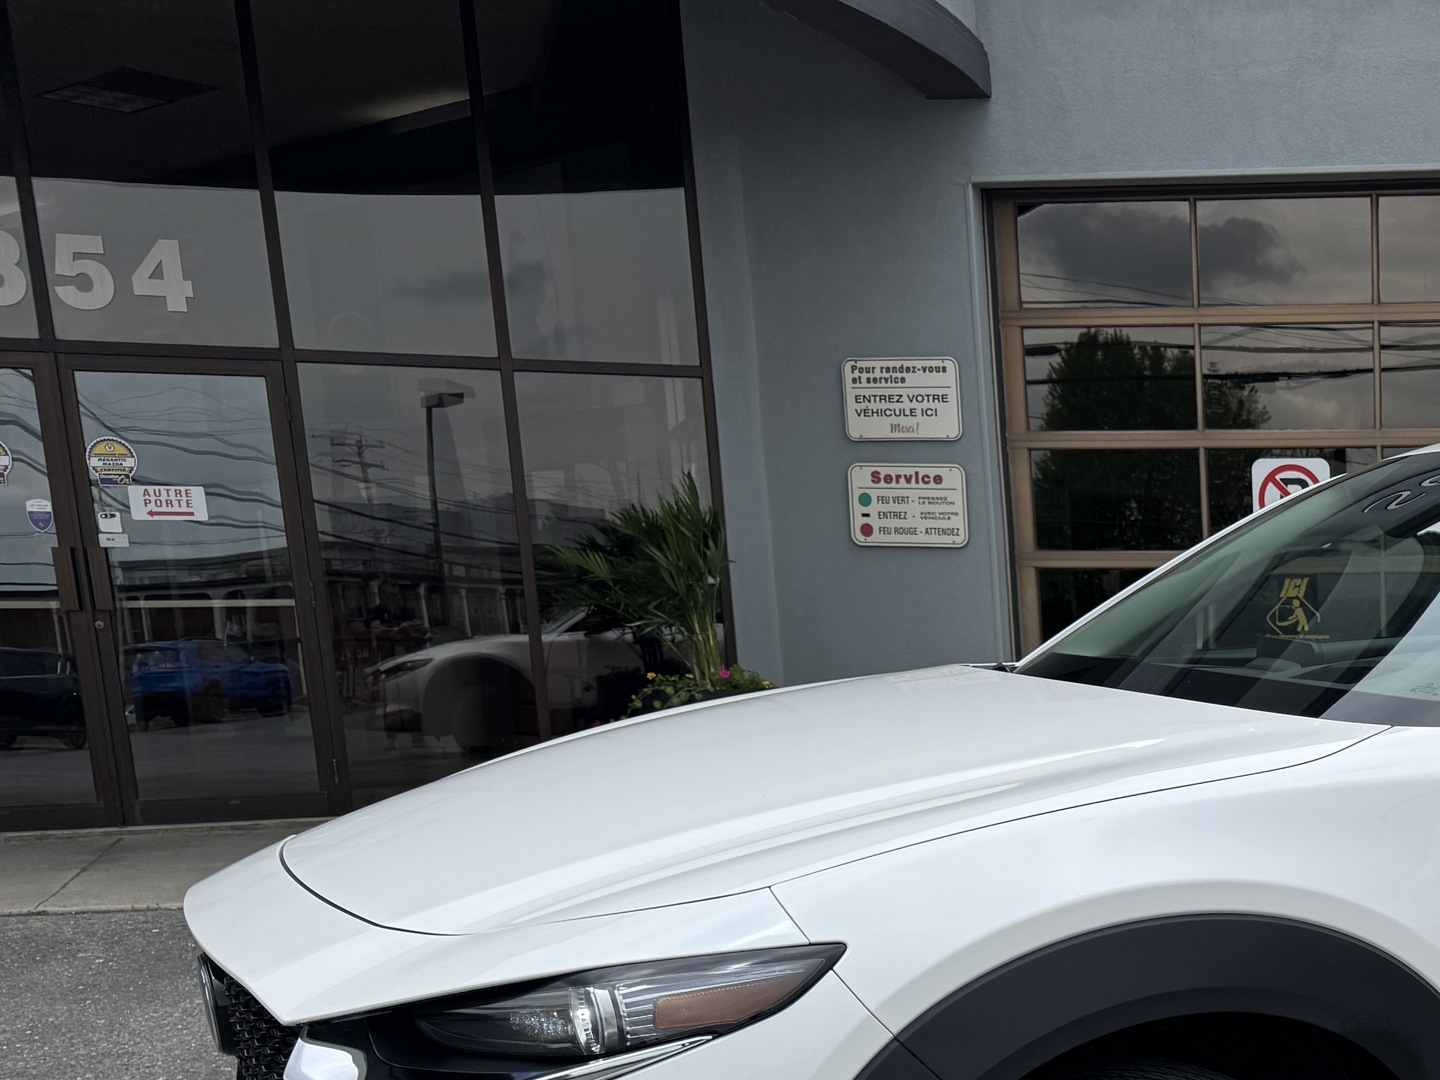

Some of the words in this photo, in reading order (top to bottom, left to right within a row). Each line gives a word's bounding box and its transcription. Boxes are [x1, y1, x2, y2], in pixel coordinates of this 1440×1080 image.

[851, 365, 876, 374] Pour
[880, 364, 948, 374] rendez-vous
[852, 376, 862, 384] et
[866, 375, 906, 384] service
[855, 394, 904, 403] ENTREZ
[907, 394, 949, 403] VOTRE
[855, 406, 917, 417] VÉHICULE
[921, 408, 938, 417] ICI
[870, 471, 943, 485] Service
[143, 488, 193, 498] AUTRE
[144, 499, 194, 508] PORTE
[877, 496, 891, 505] FEU
[892, 496, 909, 504] VERT
[878, 511, 908, 520] ENTREZ
[879, 527, 892, 535] FEU
[894, 527, 918, 535] ROUGE
[925, 528, 960, 536] ATTENDEZ
[1279, 577, 1310, 598] ICI
